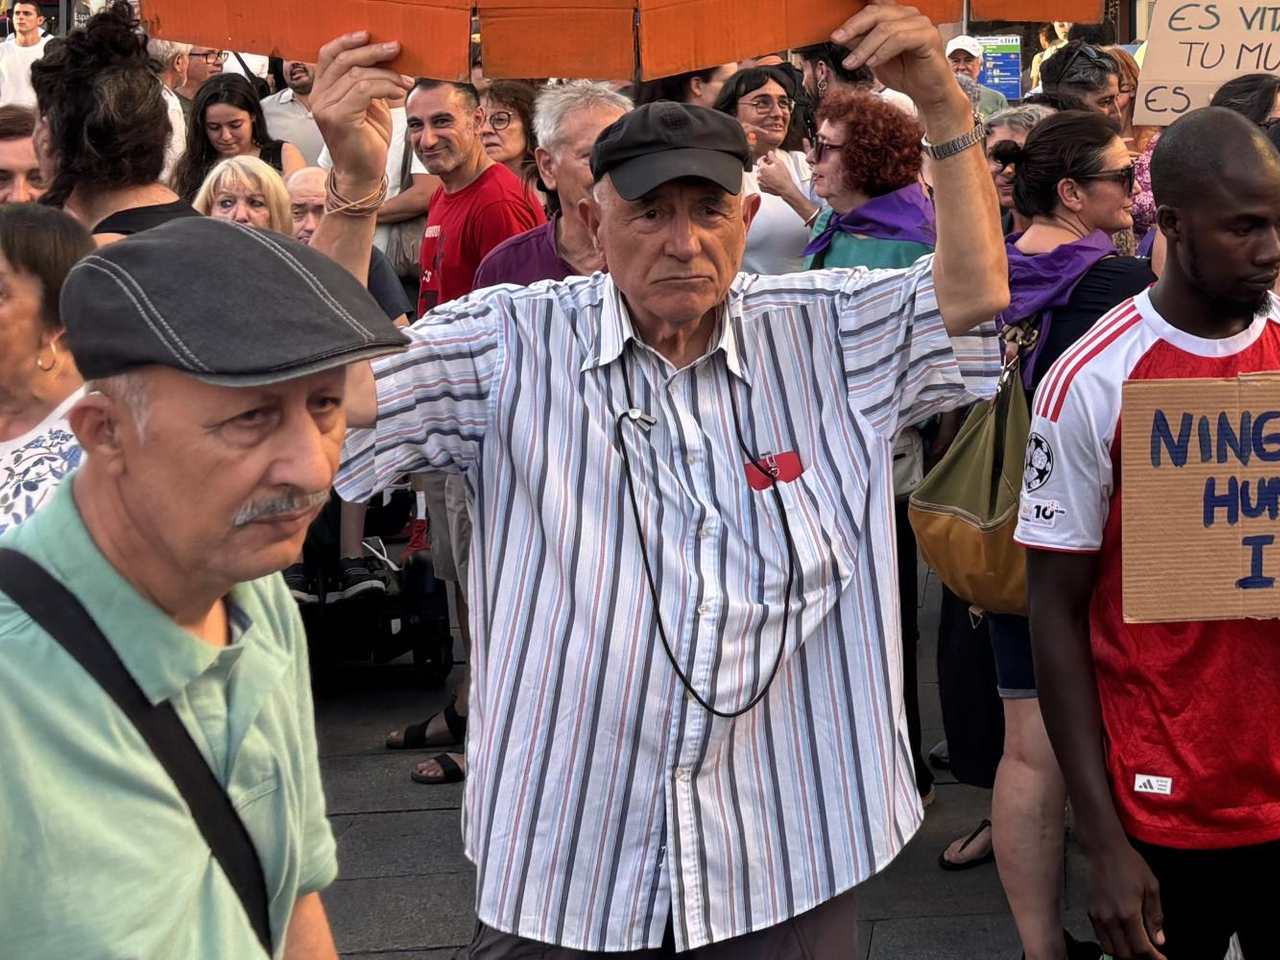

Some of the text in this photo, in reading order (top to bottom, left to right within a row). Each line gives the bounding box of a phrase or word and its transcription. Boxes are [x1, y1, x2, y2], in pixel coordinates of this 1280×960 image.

[1168, 3, 1221, 31] ES
[1179, 41, 1226, 69] TU
[1144, 86, 1191, 113] ES
